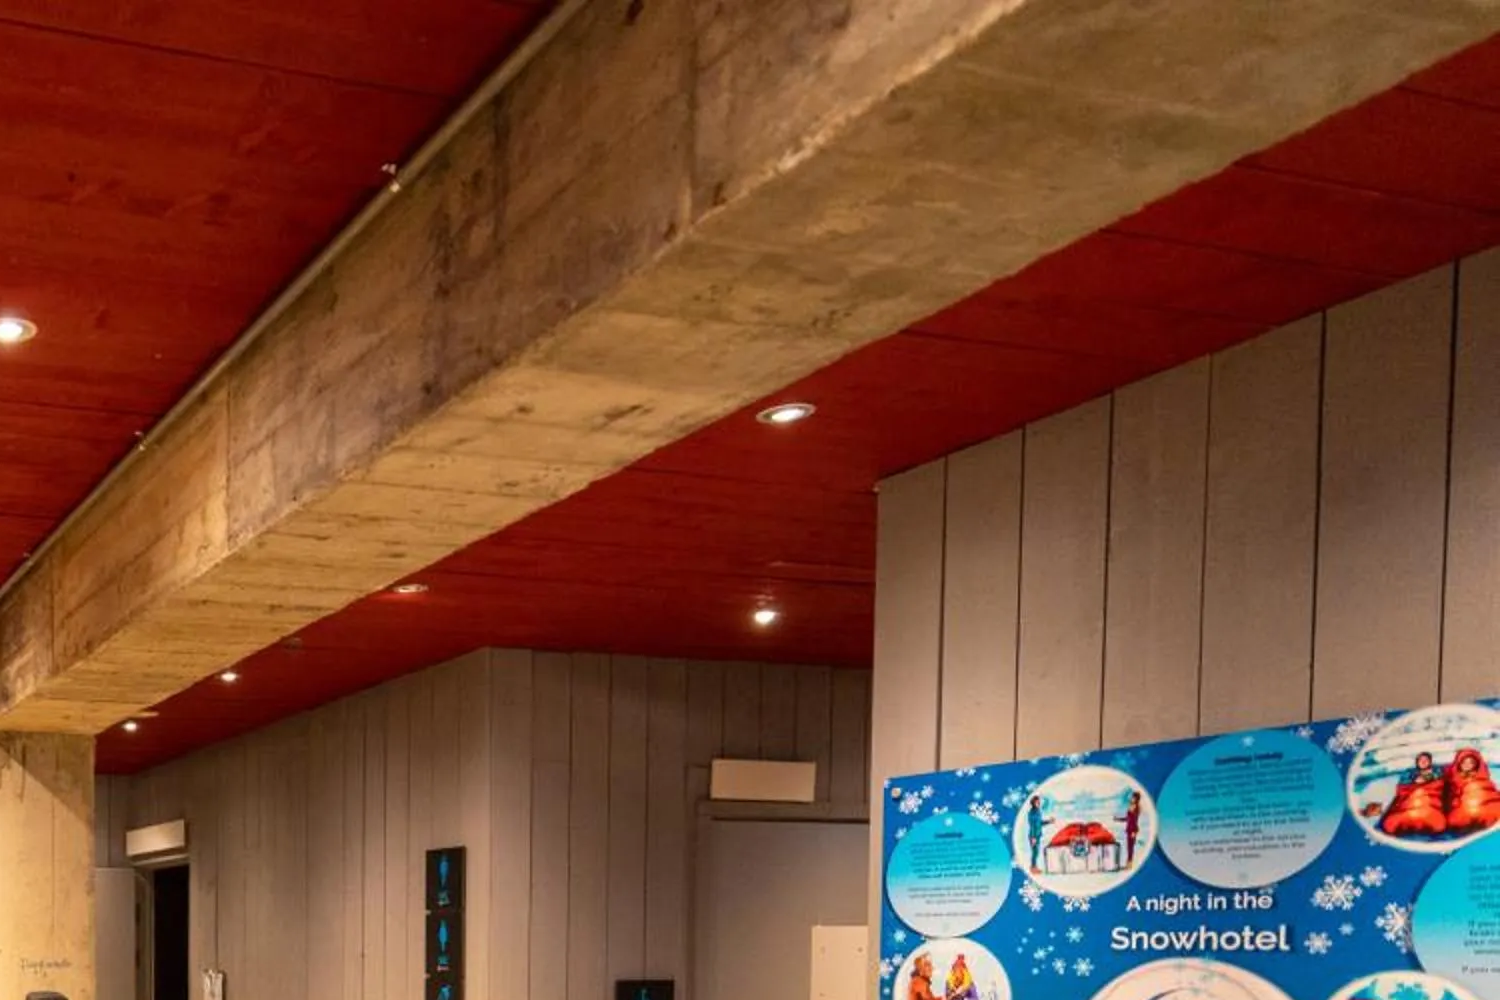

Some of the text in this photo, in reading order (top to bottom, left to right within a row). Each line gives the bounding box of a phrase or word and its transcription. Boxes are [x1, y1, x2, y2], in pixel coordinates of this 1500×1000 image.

[1125, 891, 1273, 915] A night in the
[1110, 924, 1290, 951] Snowhotel
